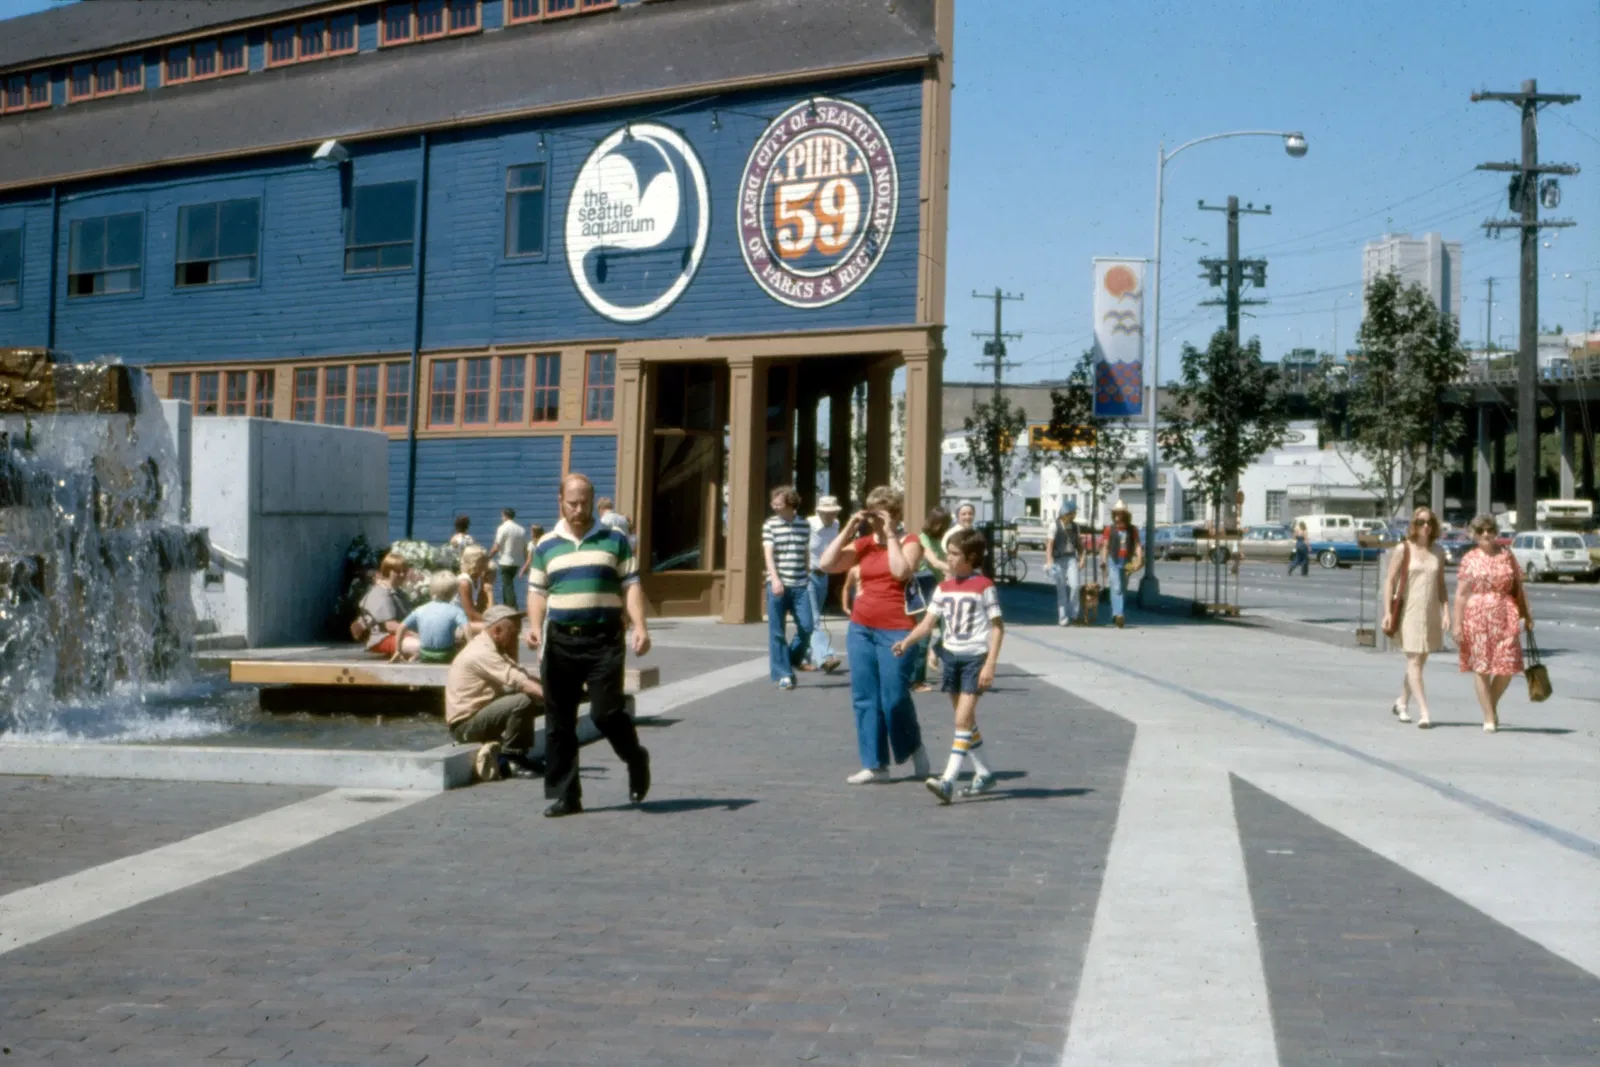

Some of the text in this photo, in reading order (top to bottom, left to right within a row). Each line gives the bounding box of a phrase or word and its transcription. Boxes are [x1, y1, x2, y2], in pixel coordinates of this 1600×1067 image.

[757, 128, 788, 167] CITY
[816, 106, 882, 155] SEATTLE
[785, 135, 848, 180] PIER
[578, 201, 633, 222] seattle
[583, 189, 608, 207] the
[775, 177, 861, 259] 59
[581, 217, 655, 238] aquarium
[748, 236, 766, 261] OF
[762, 263, 815, 298] PARKS
[819, 279, 835, 296] &
[837, 166, 891, 288] RECREATION
